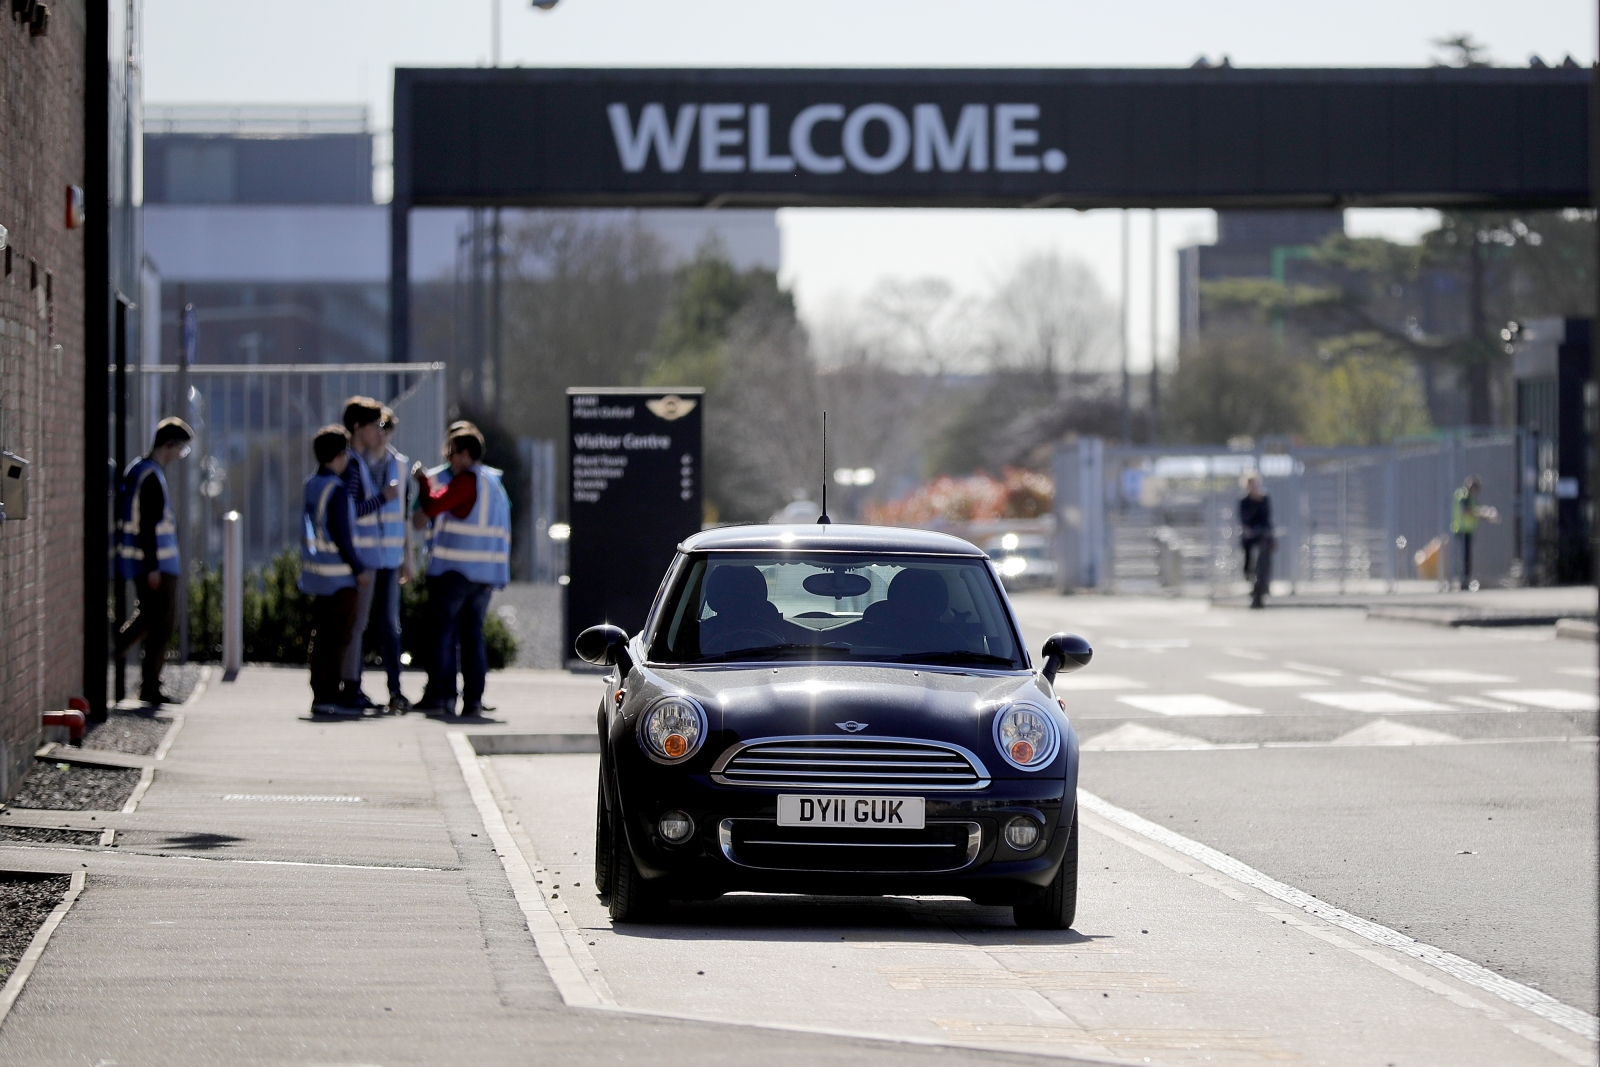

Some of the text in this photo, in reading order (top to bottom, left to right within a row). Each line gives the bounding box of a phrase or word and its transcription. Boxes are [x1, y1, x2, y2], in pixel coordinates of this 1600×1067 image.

[607, 103, 1067, 174] WELCOME.
[599, 406, 635, 418] Oxford
[574, 433, 672, 450] Visitor Centre
[799, 798, 904, 824] DY11 GUK
